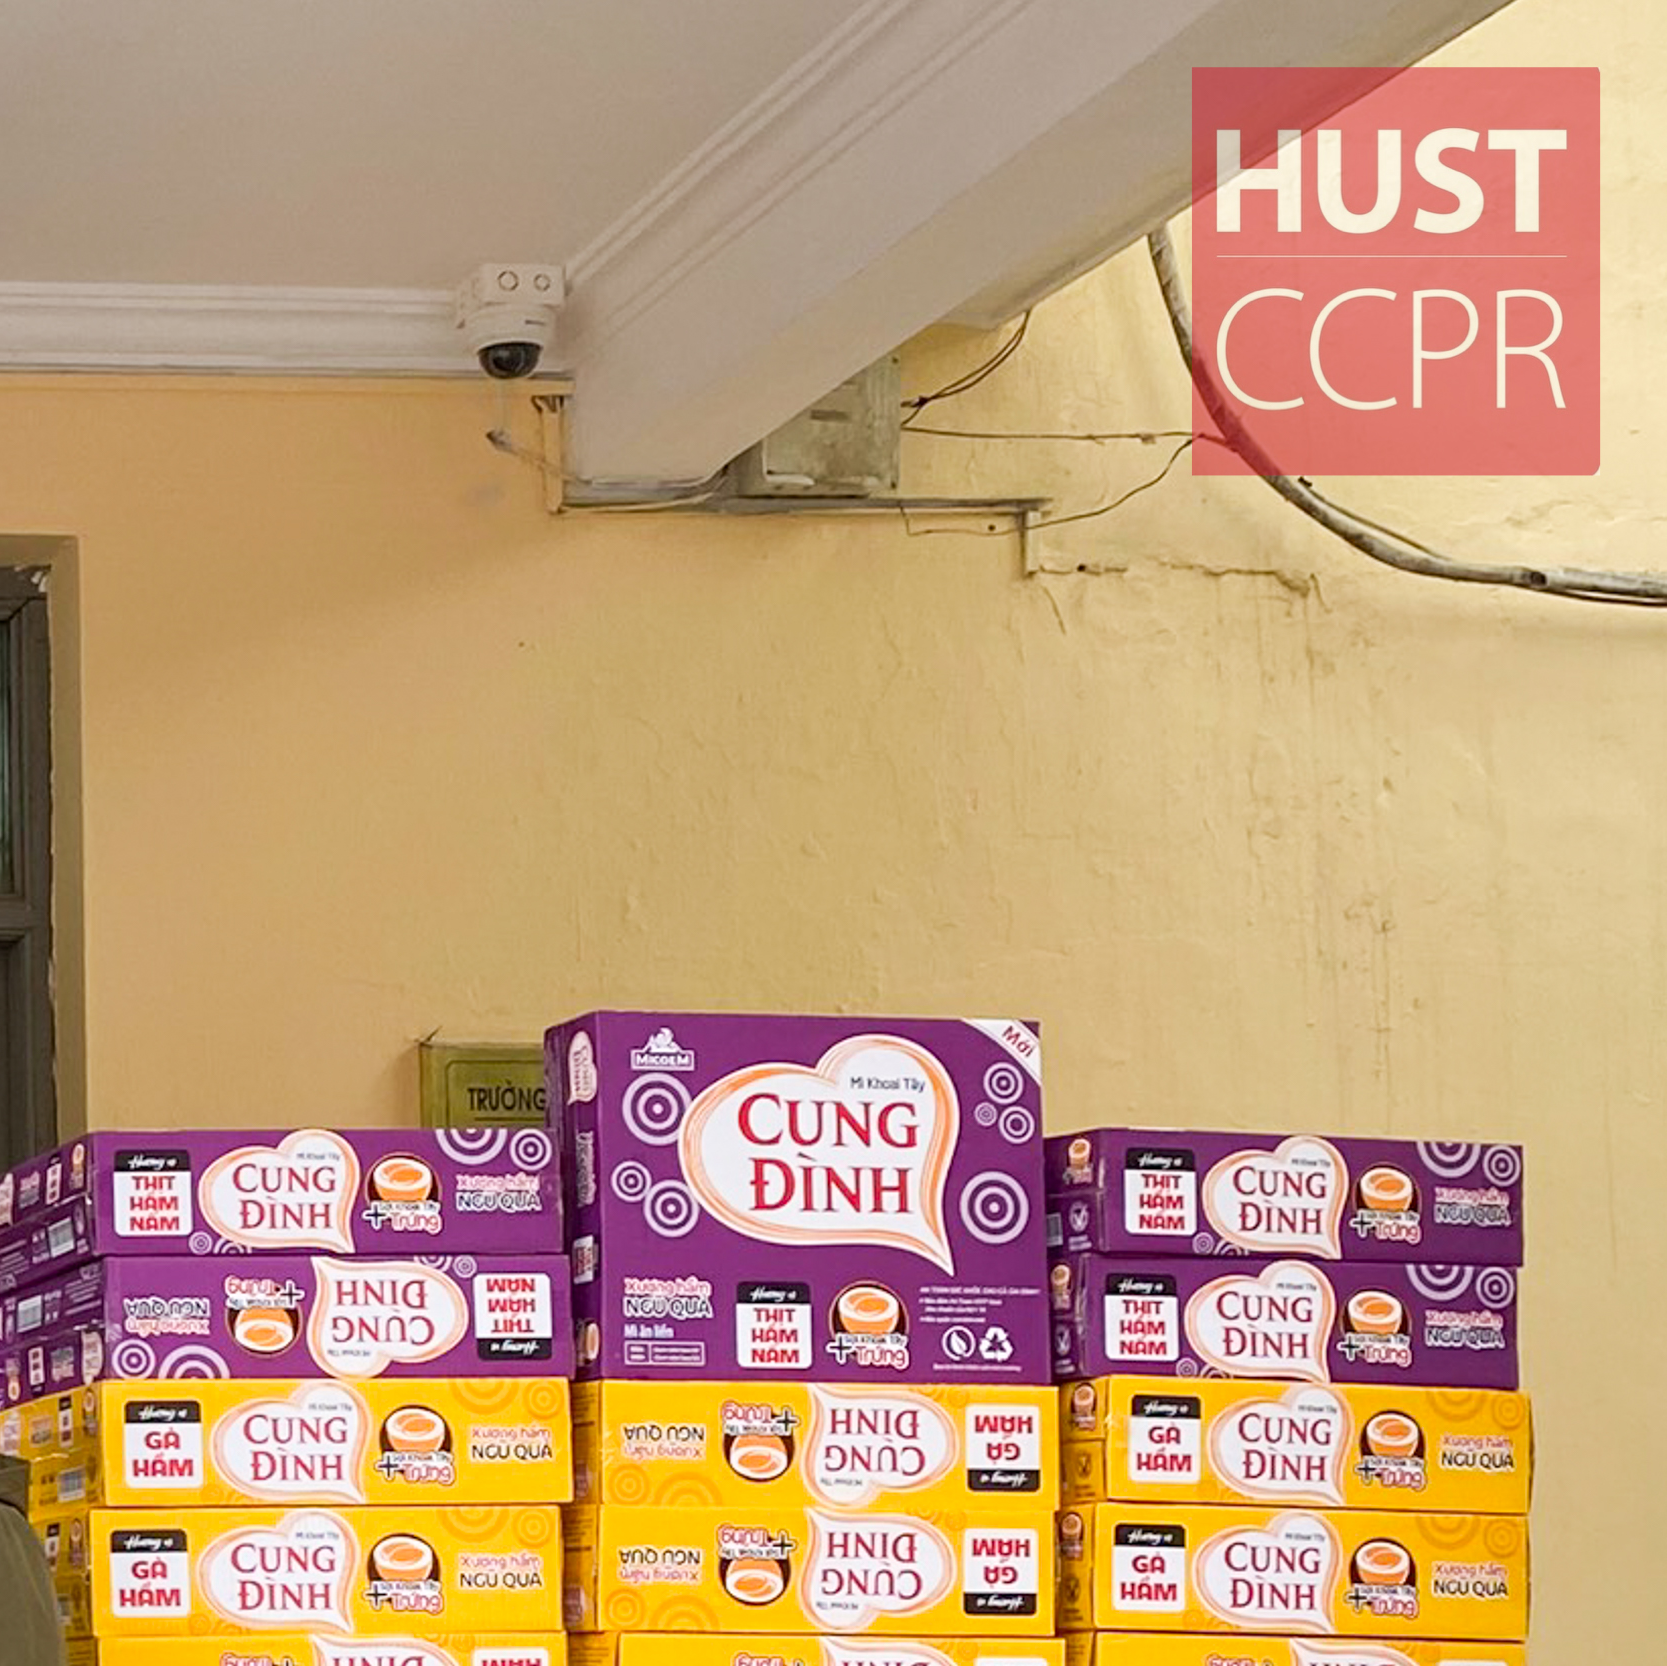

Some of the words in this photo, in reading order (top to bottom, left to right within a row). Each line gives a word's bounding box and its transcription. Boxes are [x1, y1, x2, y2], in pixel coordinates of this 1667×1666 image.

[1002, 1025, 1034, 1056] Mới
[467, 1079, 545, 1111] TRƯỜNG
[738, 1093, 920, 1148] CUNG
[231, 1165, 336, 1195] CUNG
[749, 1153, 913, 1213] ĐÌNH
[1232, 1166, 1328, 1200] CUNG
[240, 1195, 332, 1229] ĐÌNH
[1239, 1199, 1325, 1236] ĐÌNH
[331, 1315, 435, 1345] CUNG
[144, 1430, 179, 1449] GÀ
[243, 1414, 348, 1446] CUNG
[1238, 1413, 1332, 1446] CUNG
[251, 1446, 343, 1481] ĐÌNH
[824, 1446, 926, 1475] CUNG
[1243, 1445, 1327, 1482] ĐÌNH
